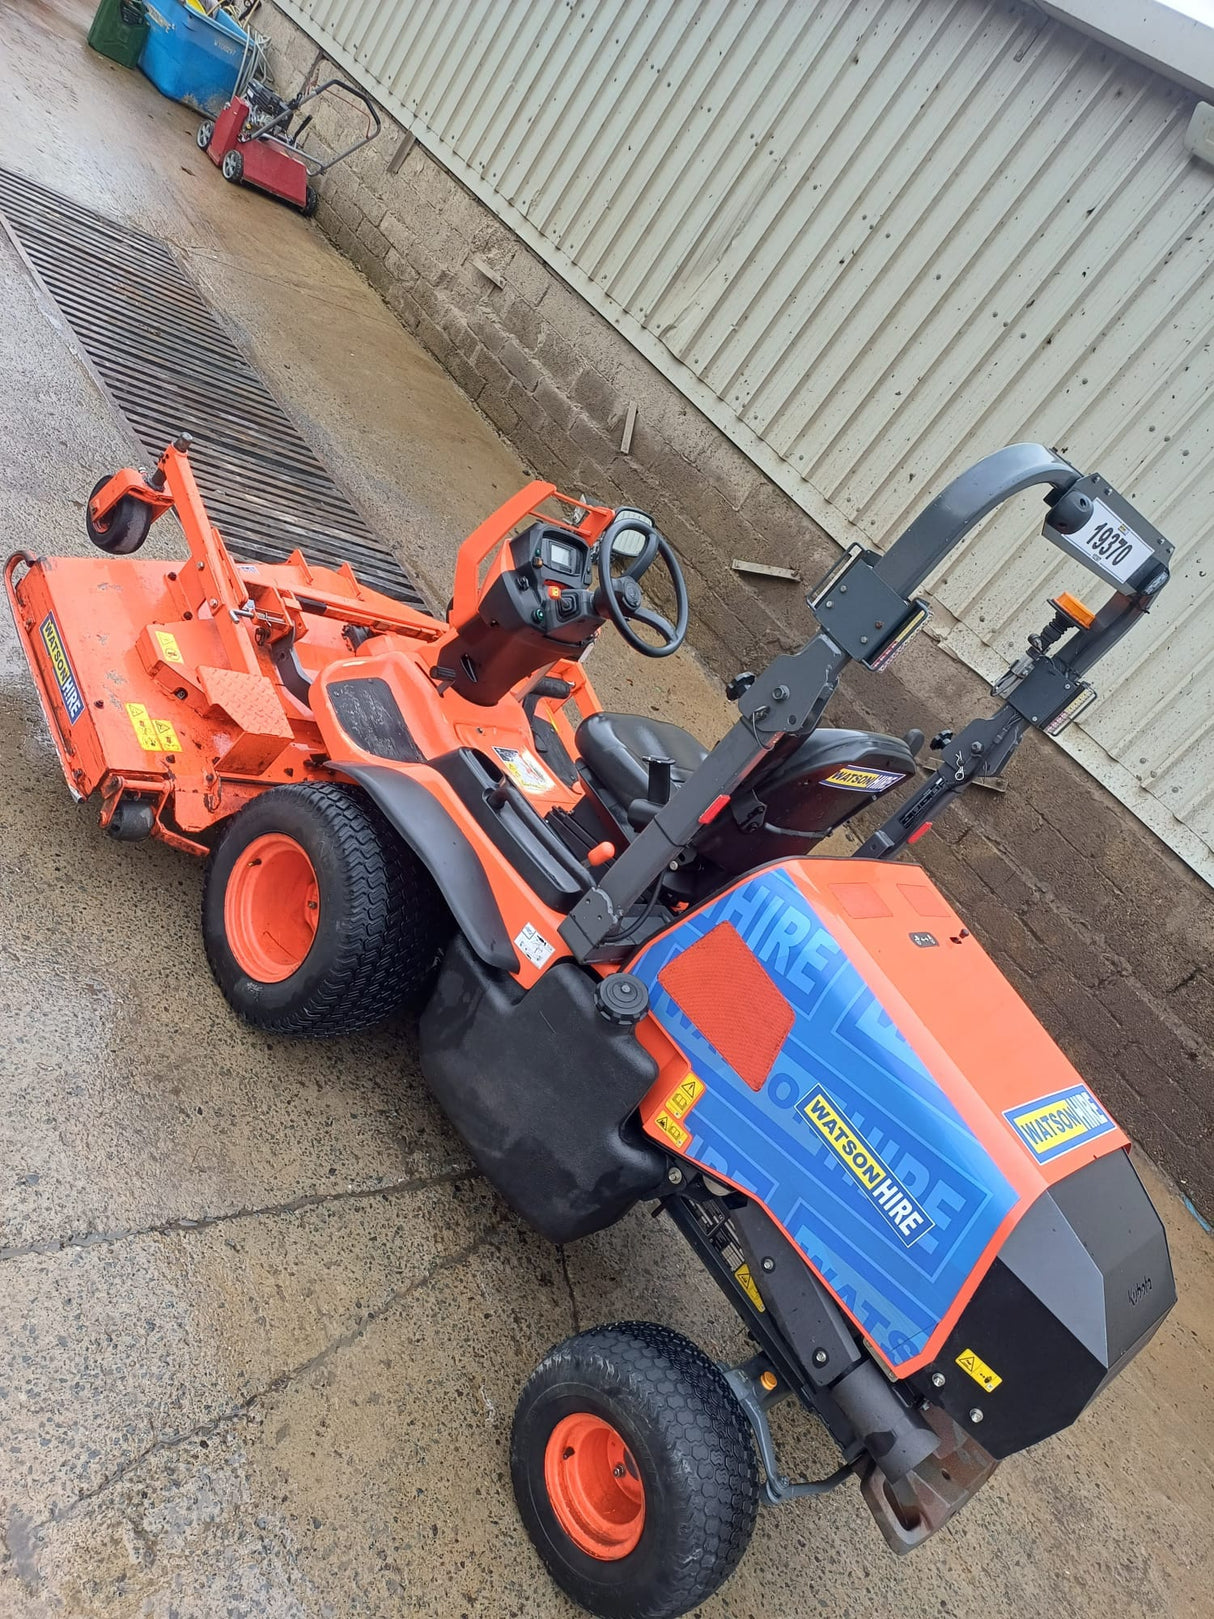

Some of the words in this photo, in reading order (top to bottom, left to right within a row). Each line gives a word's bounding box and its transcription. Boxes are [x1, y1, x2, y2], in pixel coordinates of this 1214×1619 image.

[1086, 522, 1133, 566] 19370
[45, 622, 69, 681] WATSON
[62, 676, 81, 718] HIRE
[831, 771, 876, 786] WATSON
[866, 774, 899, 790] HIRE
[1020, 1106, 1082, 1145] WATSON
[1064, 1091, 1109, 1130] HIRE
[810, 1099, 881, 1184] WATSON
[872, 1178, 925, 1237] HIRE
